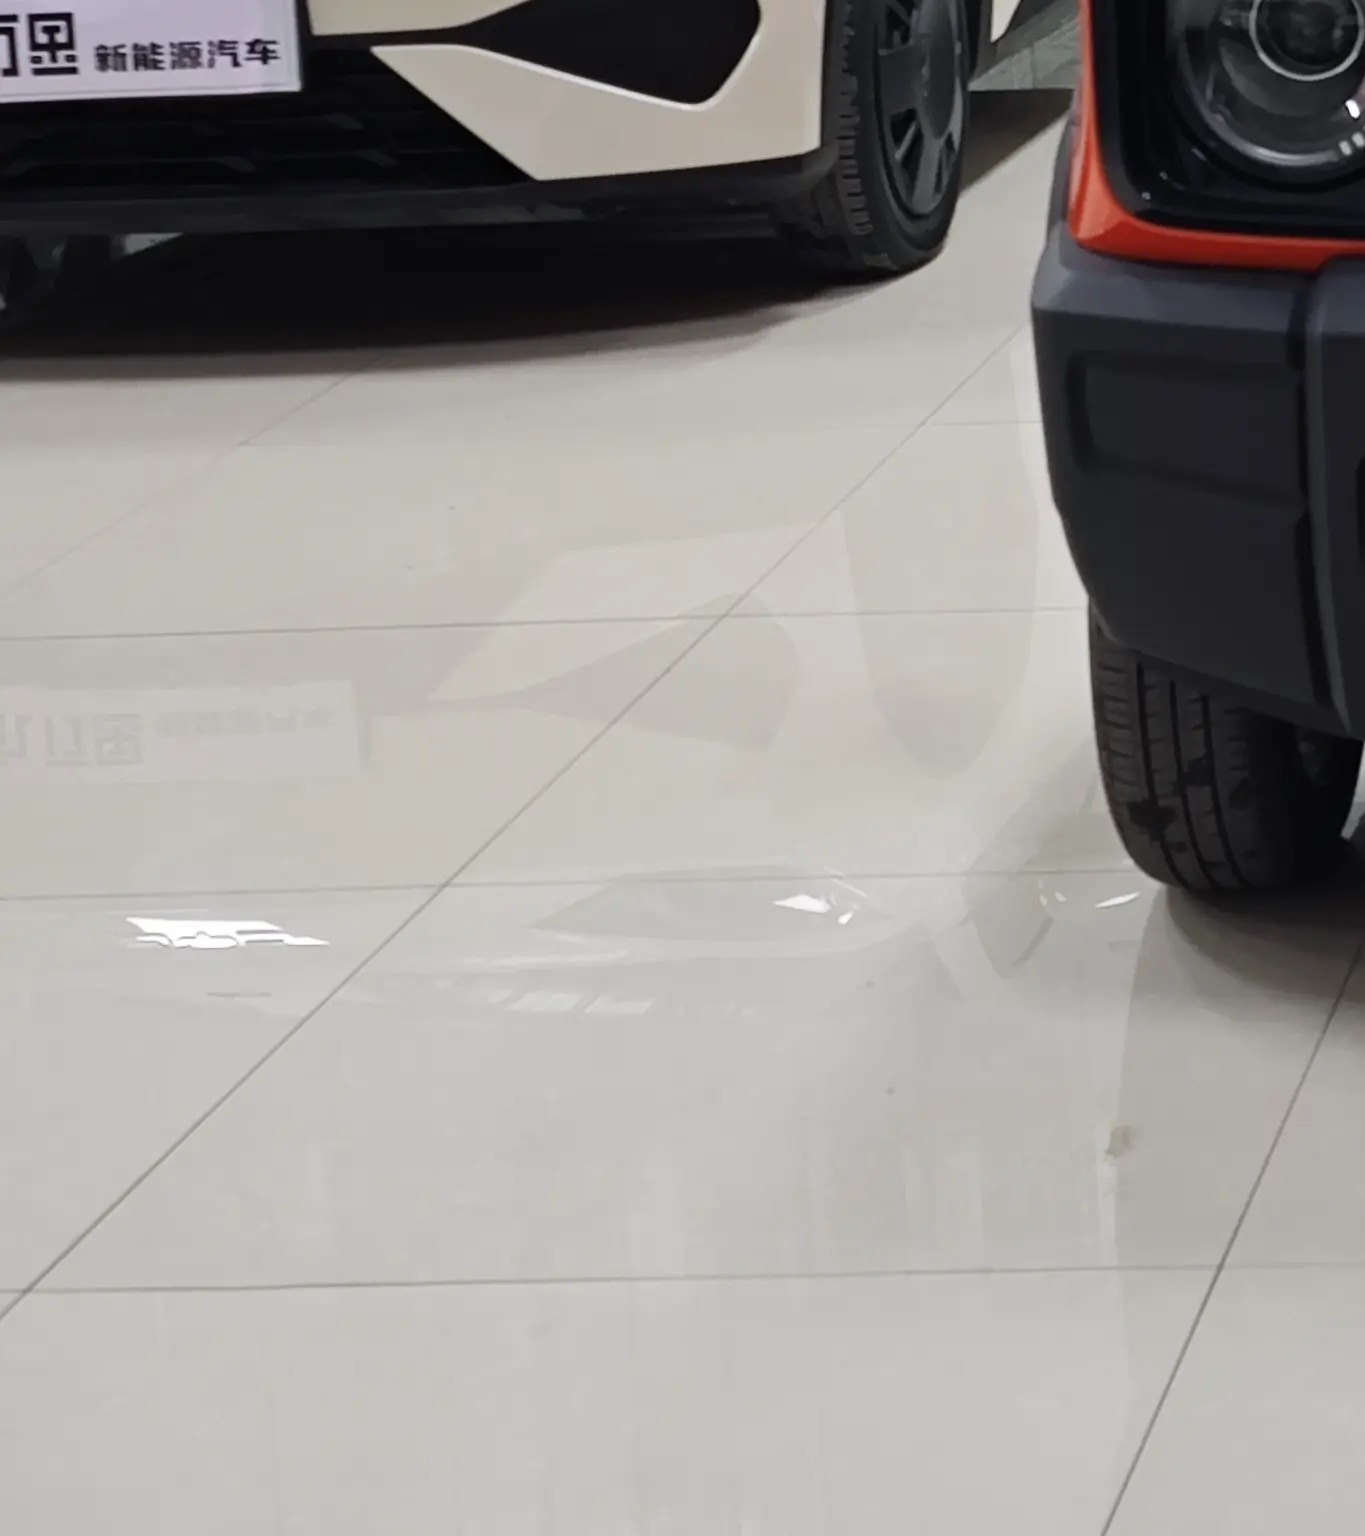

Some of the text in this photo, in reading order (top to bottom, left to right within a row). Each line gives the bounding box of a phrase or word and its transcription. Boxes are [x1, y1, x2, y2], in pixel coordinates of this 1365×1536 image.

[94, 38, 280, 72] 新能源汽车
